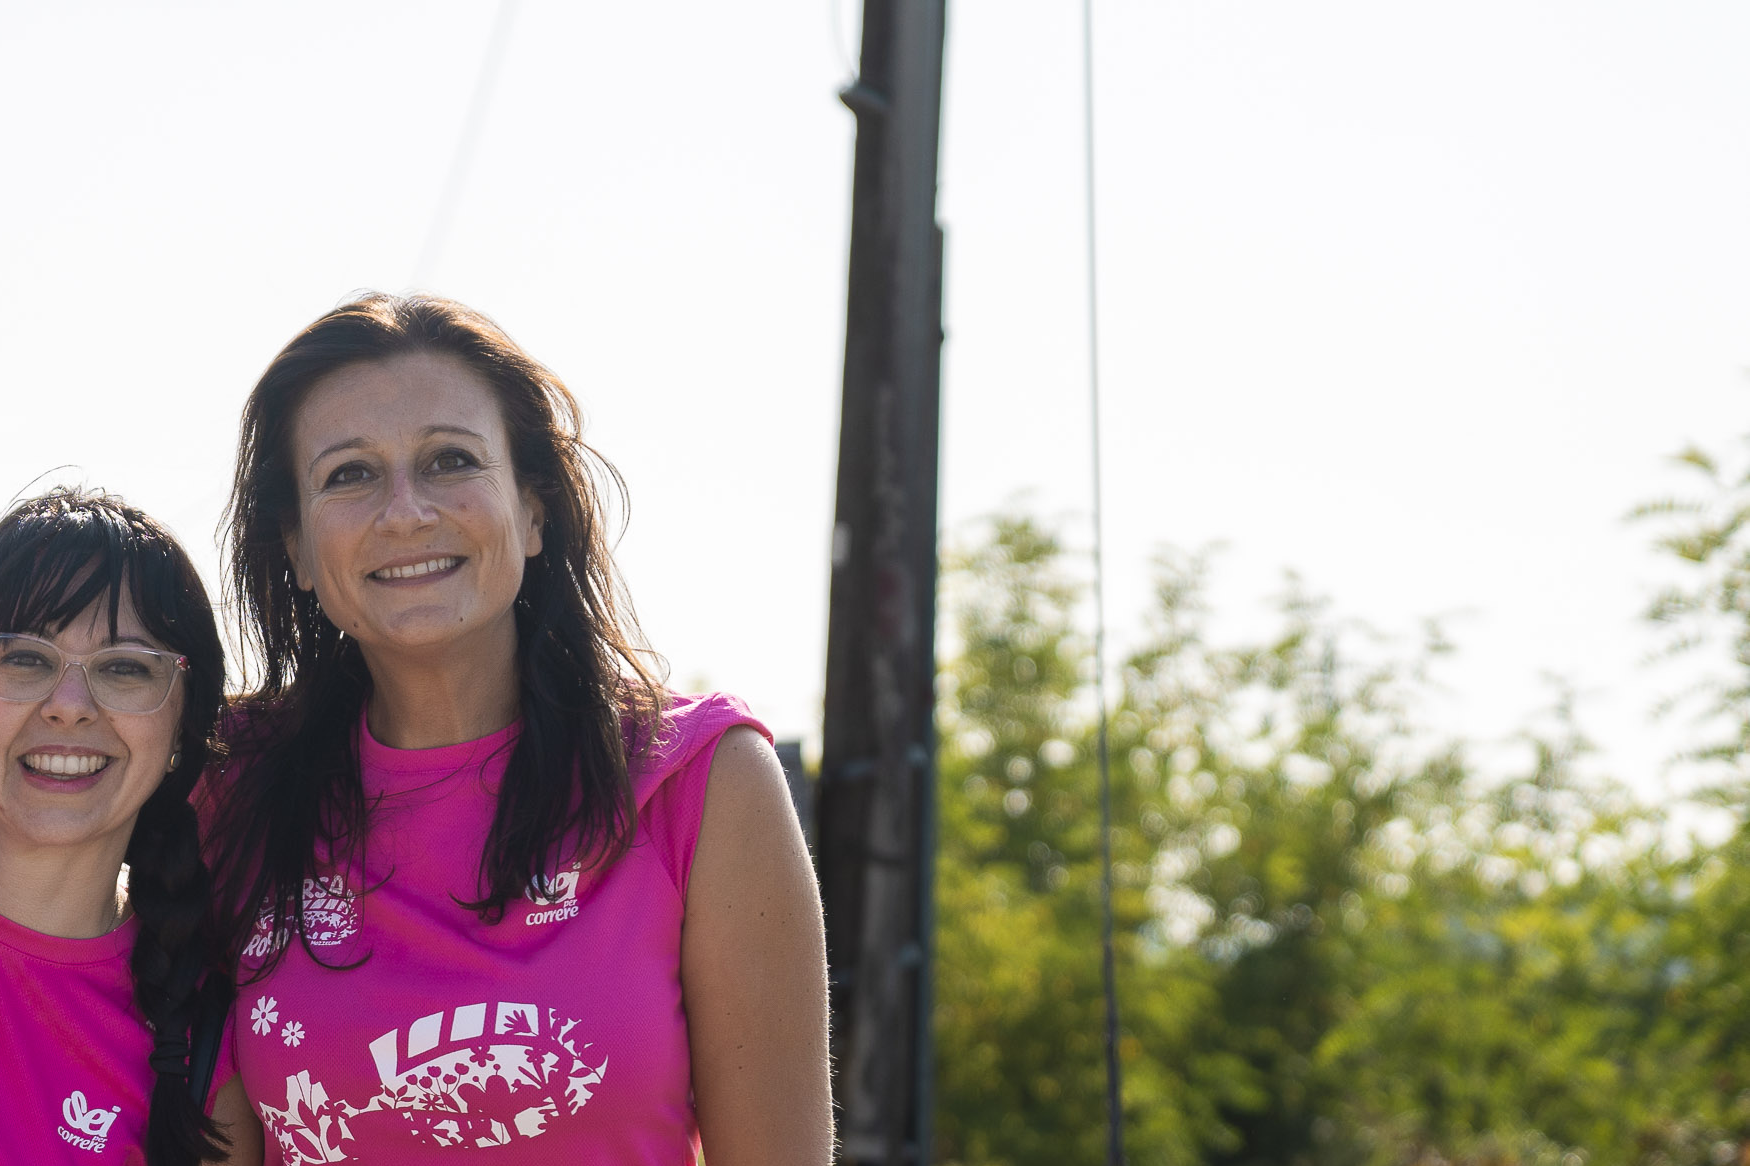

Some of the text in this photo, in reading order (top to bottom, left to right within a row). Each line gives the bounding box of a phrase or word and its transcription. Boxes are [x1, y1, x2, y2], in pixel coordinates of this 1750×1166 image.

[563, 899, 578, 908] per
[525, 906, 579, 926] correre
[62, 1090, 122, 1138] Sei
[57, 1125, 106, 1154] correre
[91, 1135, 108, 1143] per
